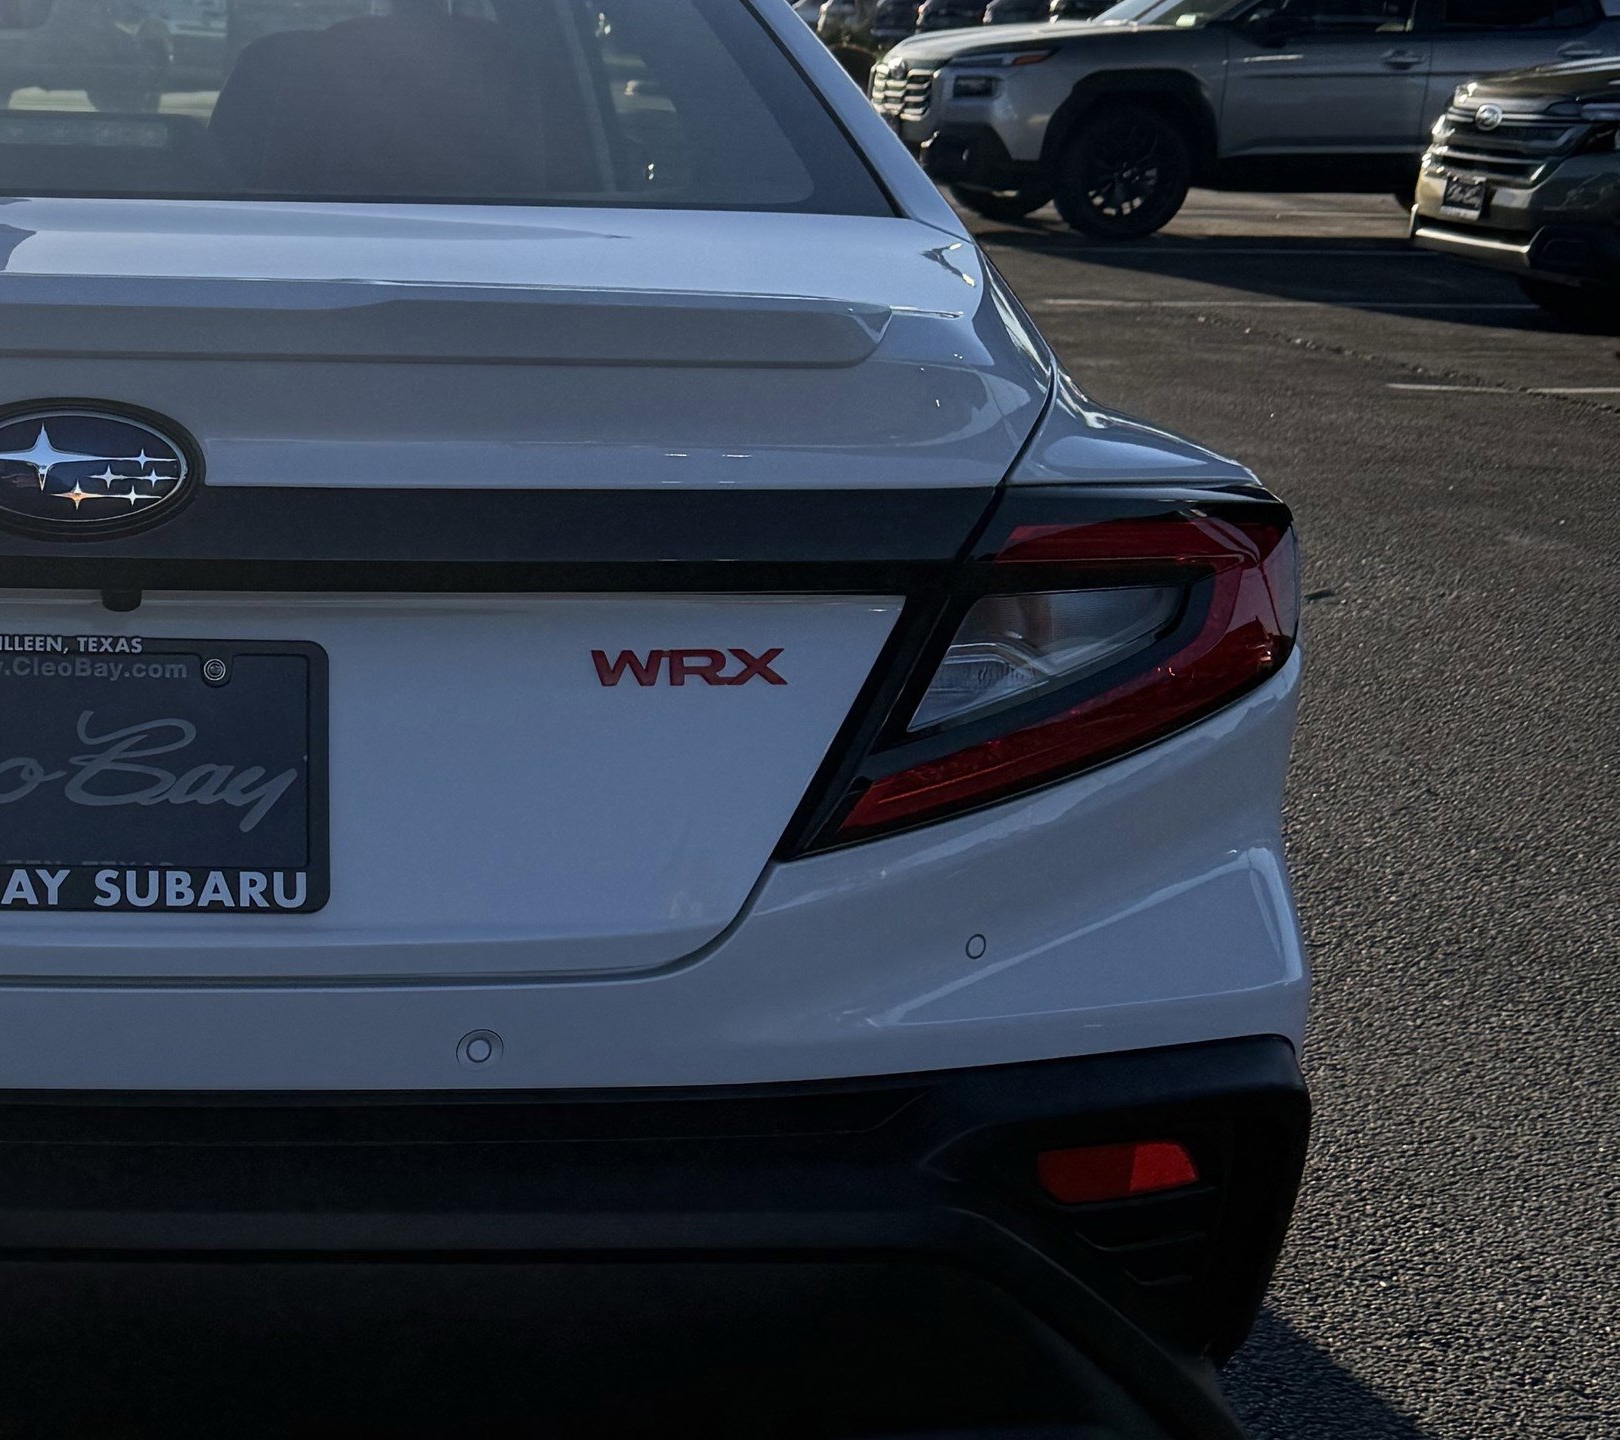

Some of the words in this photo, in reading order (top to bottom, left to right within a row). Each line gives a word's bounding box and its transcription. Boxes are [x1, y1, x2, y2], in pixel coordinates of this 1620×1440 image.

[77, 637, 143, 653] TEXAS
[591, 648, 788, 687] WRX
[62, 710, 297, 833] Bay
[94, 869, 308, 909] SUBARU
